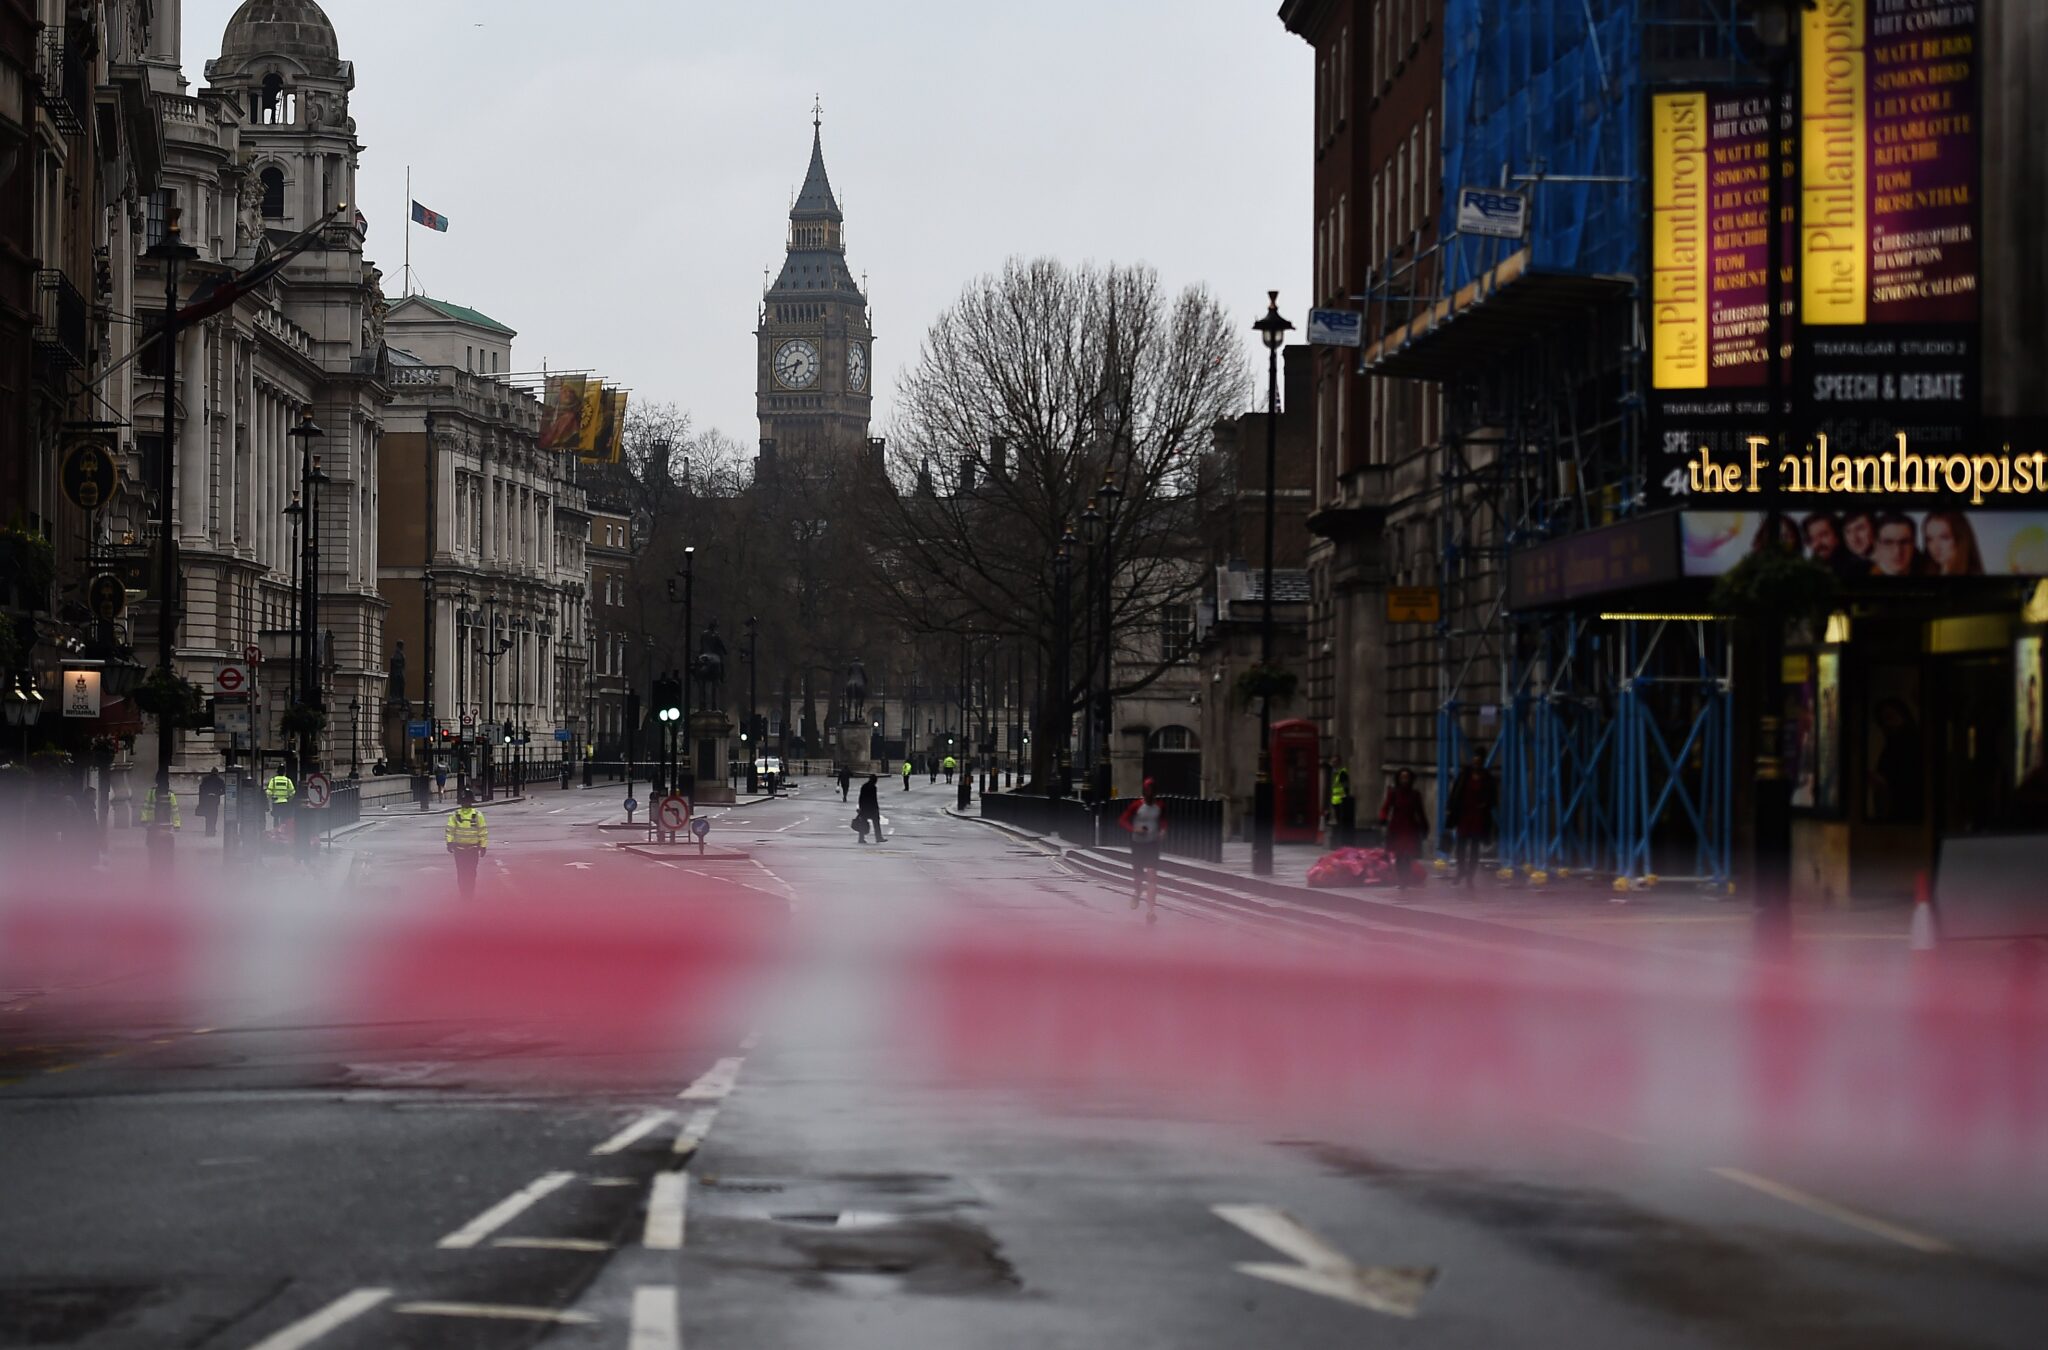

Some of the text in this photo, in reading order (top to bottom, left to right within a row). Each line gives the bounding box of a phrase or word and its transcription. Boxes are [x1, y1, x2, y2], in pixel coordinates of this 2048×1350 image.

[1905, 5, 1975, 32] COMEDY
[1874, 34, 1972, 64] MATT BERRY
[1873, 68, 1926, 90] SIMON
[1910, 91, 1951, 114] COLE
[1874, 114, 1970, 144] CHARLOTTE
[1713, 145, 1751, 164] MATT
[1802, 0, 1865, 306] the Philanthropis
[1712, 166, 1757, 187] SIMON
[1876, 170, 1912, 193] TOM
[1463, 191, 1521, 217] RBS
[1874, 185, 1969, 216] ROSENTHAL
[1653, 97, 1707, 369] the Philanthropist
[1872, 224, 1972, 253] CHRISTOPHER
[1715, 253, 1745, 273] TOM
[1872, 281, 1919, 303] SIMON
[1920, 275, 1976, 298] CALLOW
[1312, 311, 1358, 331] RBS
[1712, 349, 1752, 368] SIMON
[1813, 341, 1896, 357] TRAFALGAR
[1901, 341, 1954, 356] STUDIO
[1813, 372, 1964, 401] SPEECH & DEBATE
[1687, 445, 1743, 493] the
